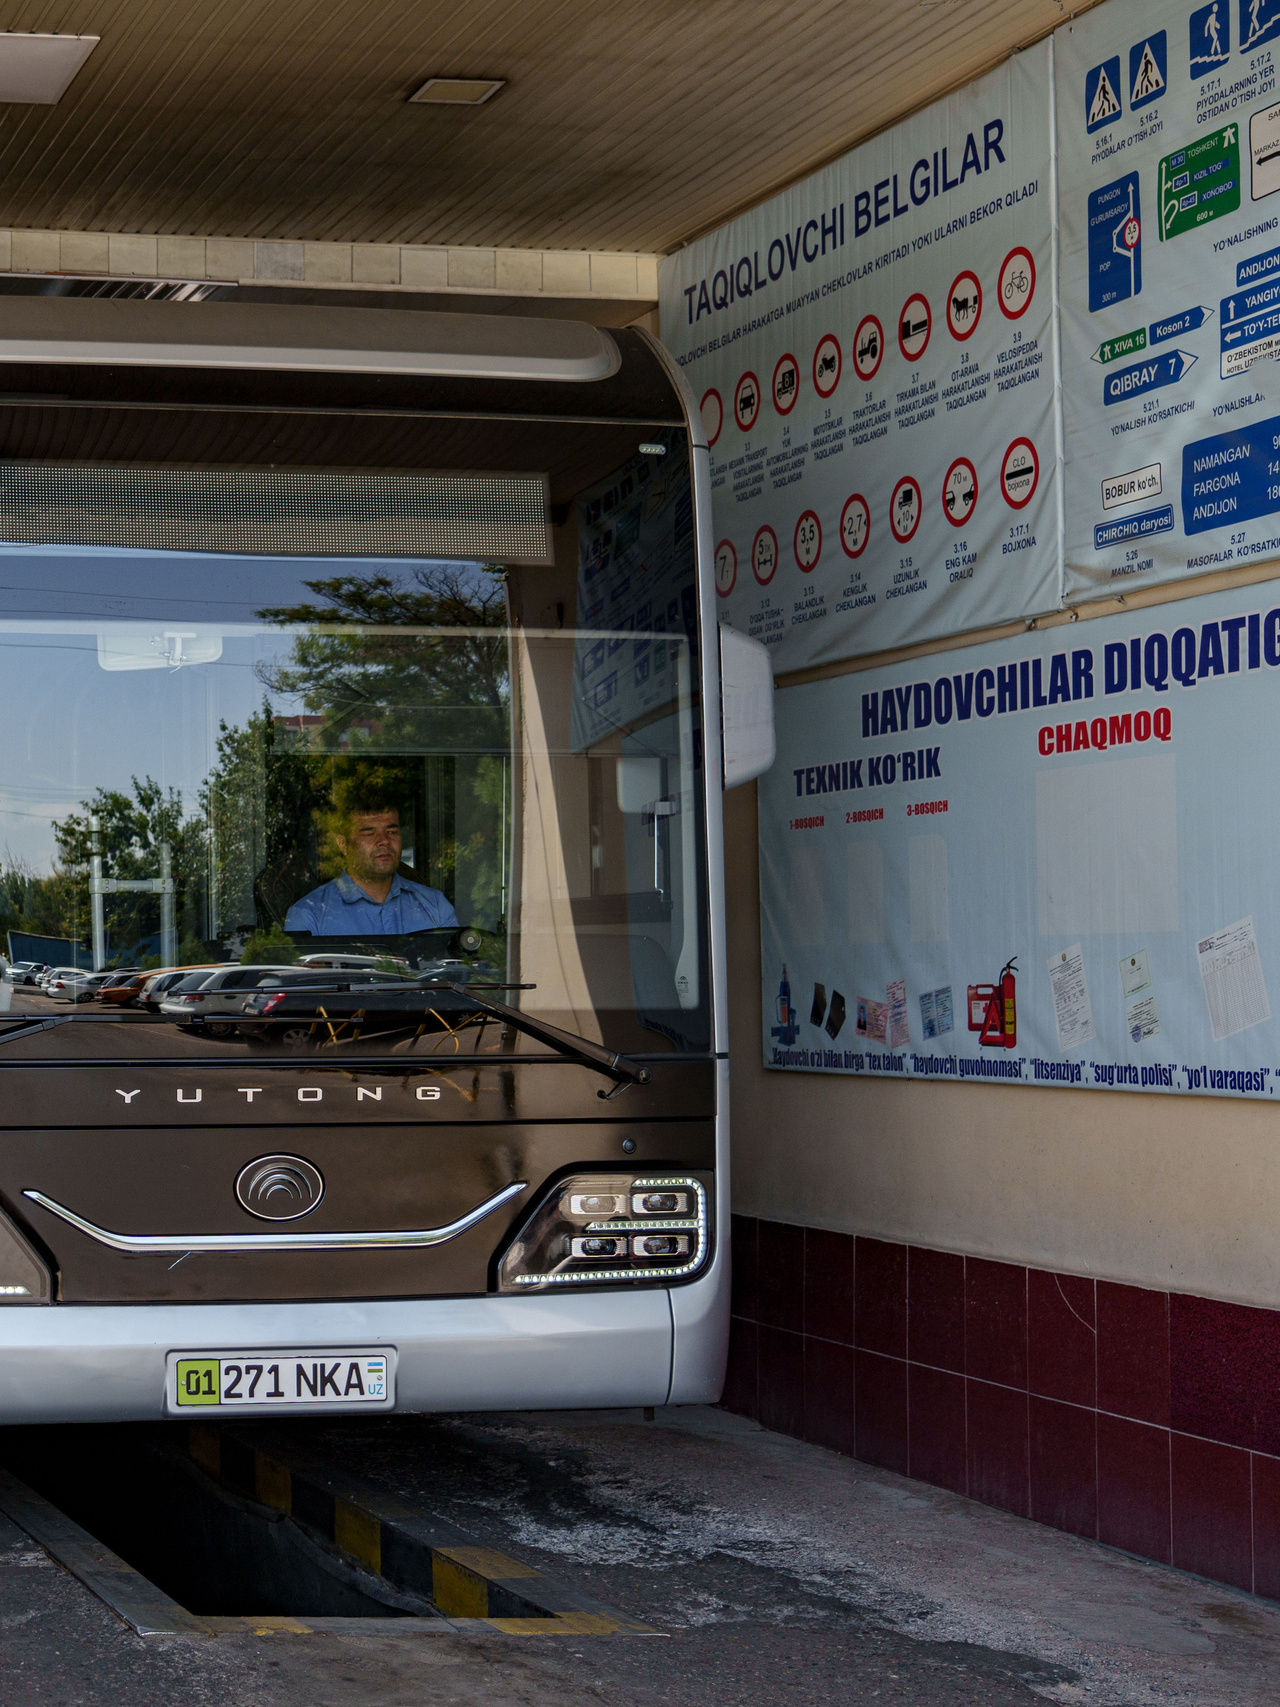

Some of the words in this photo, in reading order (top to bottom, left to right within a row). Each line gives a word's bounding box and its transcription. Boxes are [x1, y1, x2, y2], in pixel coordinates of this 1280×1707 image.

[1250, 52, 1271, 70] 5.17.2
[1197, 74, 1257, 111] PIYODALARNING
[1259, 65, 1274, 80] YER
[1201, 78, 1220, 95] 5.17.1
[1197, 101, 1230, 124] OSTIDAN
[1258, 78, 1275, 95] JOYI
[1140, 110, 1158, 127] 5.16.2
[1092, 140, 1126, 164] PIYODALAR
[1148, 121, 1163, 138] JOYI
[1096, 134, 1112, 149] 5.16.1
[1188, 137, 1218, 158] TOSHKENT
[1193, 168, 1208, 181] KIZIL
[1202, 181, 1232, 200] XONOBOD
[684, 203, 845, 325] TAQIQLOVCHI
[853, 118, 1006, 239] BELGILAR
[1196, 211, 1208, 222] 600
[1213, 217, 1278, 252] YO'NALISHNING
[709, 329, 741, 353] BELGILAR
[742, 306, 784, 335] HARAKATGA
[786, 288, 820, 314] MUAYYAN
[822, 262, 873, 297] CHEKLOVLAR
[875, 243, 910, 271] KIRITADI
[912, 232, 932, 253] YOKI
[934, 215, 968, 242] ULARNI
[970, 198, 1003, 225] BEKOR
[1005, 180, 1038, 208] QILADI
[1100, 261, 1111, 273] POP
[1239, 254, 1280, 280] ANDIJON
[1245, 286, 1280, 308] YANGIY
[1157, 321, 1182, 338] Koson
[1185, 316, 1190, 327] 2
[1243, 313, 1280, 337] TO'Y-TE
[1013, 332, 1022, 343] 3.9
[1114, 338, 1133, 353] XIVA
[1135, 334, 1144, 346] 16
[961, 352, 969, 364] 3.8
[997, 340, 1038, 364] VELOSIPEDDA
[951, 363, 979, 382] OT-ARAVA
[994, 352, 1042, 380] HARAKATLANISH
[1227, 364, 1243, 374] HOTEL
[942, 373, 990, 400] HARAKATLANISHI
[997, 368, 1039, 392] TAQIQLANGAN
[1110, 364, 1158, 396] QIBRAY
[1168, 358, 1176, 375] 7
[896, 387, 919, 403] TIRKAMA
[920, 380, 936, 394] BILAN
[946, 388, 986, 412] TAQIQLANGAN
[853, 400, 886, 420] TRAKTORLAR
[894, 392, 938, 418] HARAKATLANISHI
[1143, 399, 1160, 413] 5.21.1
[849, 411, 891, 435] HARAKATLANISHI
[898, 408, 935, 429] TAQIQLANGAN
[852, 426, 887, 447] TAQIQLANGAN
[1194, 444, 1250, 473] NAMANGAN
[953, 472, 961, 485] 70
[1008, 478, 1030, 491] bojxona
[1194, 472, 1240, 497] FARGONA
[1105, 481, 1136, 501] BOBUR
[903, 510, 909, 522] 10
[1193, 497, 1237, 521] ANDIJON
[800, 524, 815, 545] 3,5
[847, 514, 863, 536] 2,7
[1009, 524, 1029, 538] 3.17.1
[1097, 524, 1139, 543] CHIRCHIQ
[1140, 513, 1171, 532] daryosi
[954, 541, 968, 554] 3.16
[1002, 536, 1037, 554] BOJXONA
[1231, 532, 1246, 545] 5.27
[900, 557, 912, 569] 3.15
[945, 558, 960, 570] ENG
[962, 552, 977, 565] KAM
[1111, 562, 1136, 578] MANZIL
[1137, 559, 1153, 571] NOMI
[1187, 550, 1233, 569] MASOFALAR
[850, 572, 861, 583] 3.14
[893, 568, 920, 584] UZUNLIK
[950, 568, 974, 583] ORALIQ
[804, 586, 814, 597] 3.13
[843, 583, 868, 598] KENGLIK
[886, 580, 927, 600] CHEKLANGAN
[794, 595, 825, 612] BALANDLIK
[836, 594, 876, 613] CHEKLANGAN
[792, 607, 827, 625] CHEKLANGAN
[861, 648, 1095, 738] HAYDOVCHILAR
[1038, 707, 1172, 756] CHAQMOQ
[793, 759, 863, 797] TEXNIK
[789, 816, 824, 830] 1-BOSQICH
[846, 808, 884, 824] 2-BOSQICH
[907, 800, 948, 816] 3-BOSQICH
[823, 1049, 843, 1068] bilan
[844, 1050, 864, 1071] birga
[115, 1087, 440, 1103] YUTONG
[186, 1369, 216, 1395] 01
[224, 1364, 285, 1398] 271
[296, 1362, 365, 1397] NKA
[368, 1384, 383, 1395] UZ
